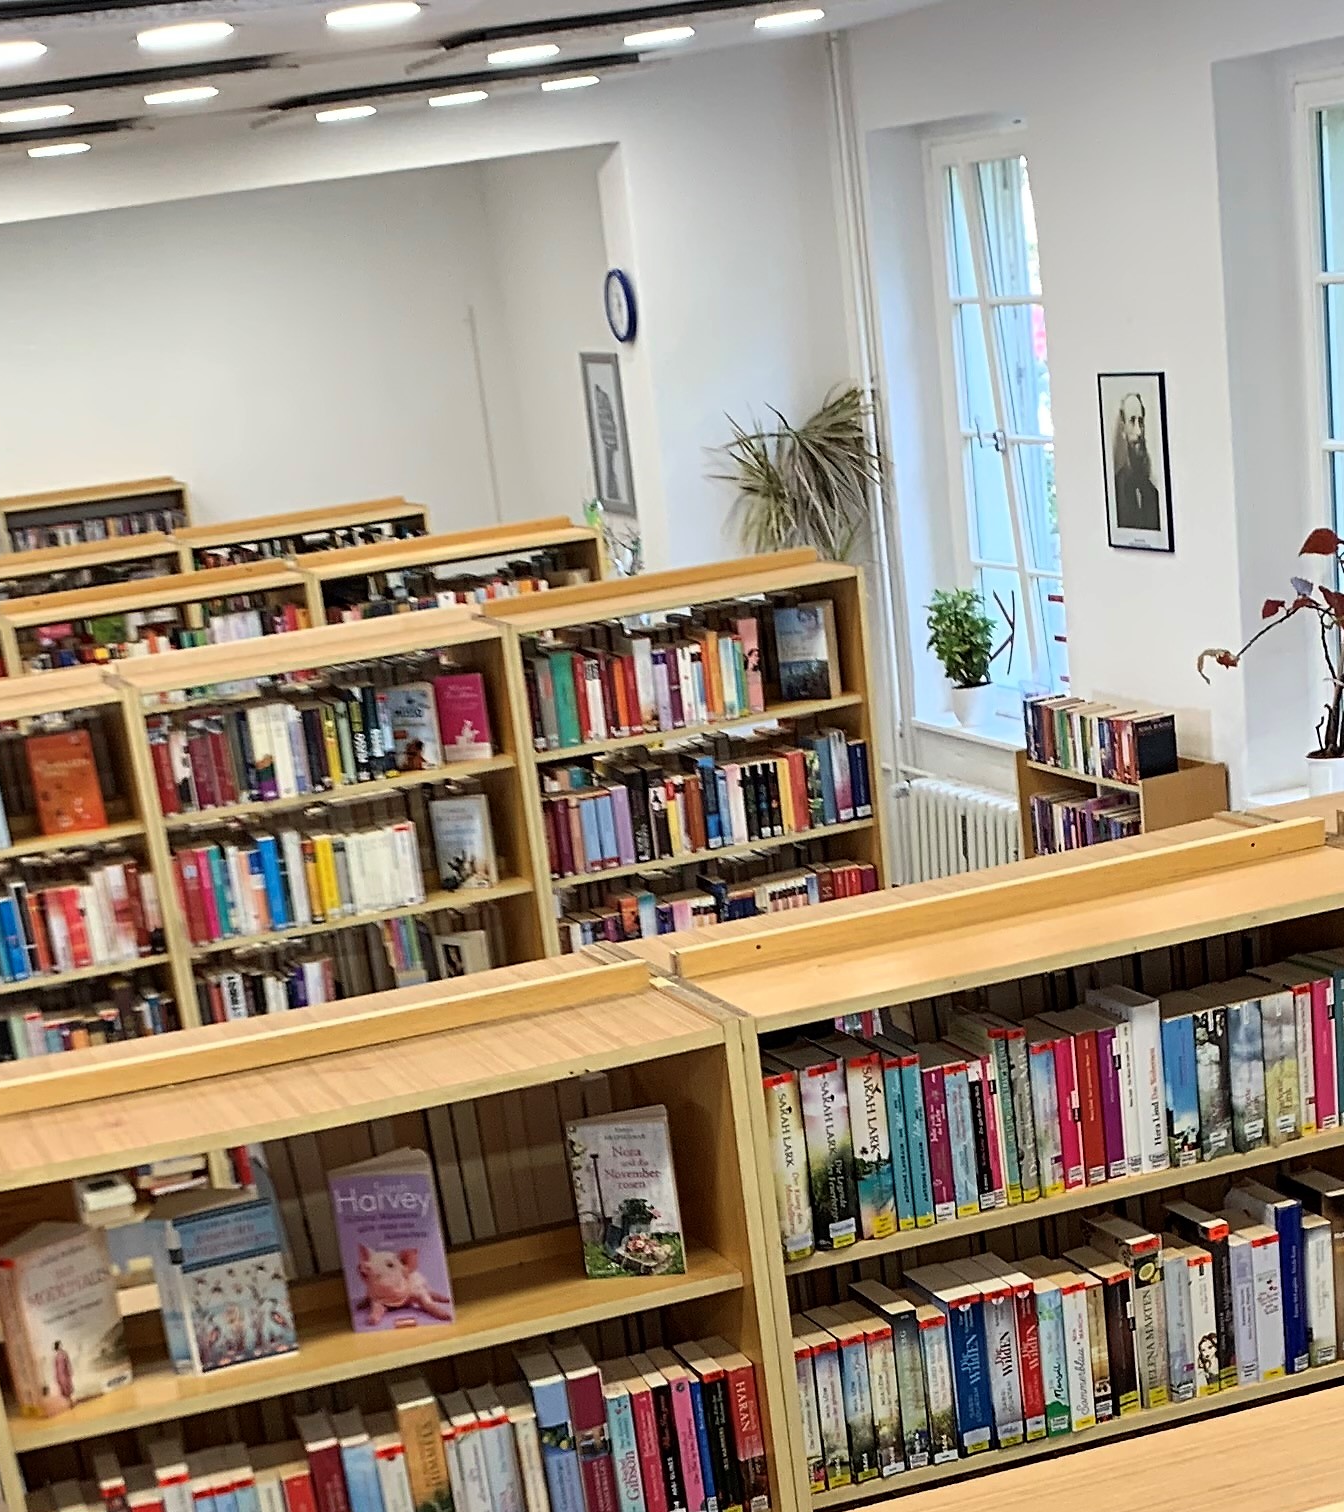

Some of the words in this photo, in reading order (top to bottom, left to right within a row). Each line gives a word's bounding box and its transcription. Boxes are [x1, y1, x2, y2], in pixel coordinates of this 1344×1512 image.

[819, 1080, 836, 1123] SARAH
[861, 1066, 880, 1115] SARAH
[777, 1092, 794, 1135] SARAH
[1153, 1101, 1162, 1122] Lind
[610, 1145, 642, 1159] Nora
[782, 1134, 795, 1168] LARK
[825, 1122, 839, 1156] LARK
[866, 1114, 881, 1154] LARK
[1154, 1123, 1163, 1146] Hera
[333, 1187, 431, 1220] Harvey
[617, 1178, 648, 1191] rosen
[1142, 1288, 1153, 1340] MARTEN
[1054, 1362, 1064, 1401] Mansell
[1075, 1348, 1089, 1416] Sommerblau
[1146, 1339, 1159, 1390] HELENA
[734, 1379, 753, 1434] HARAN
[625, 1450, 640, 1502] Gibson
